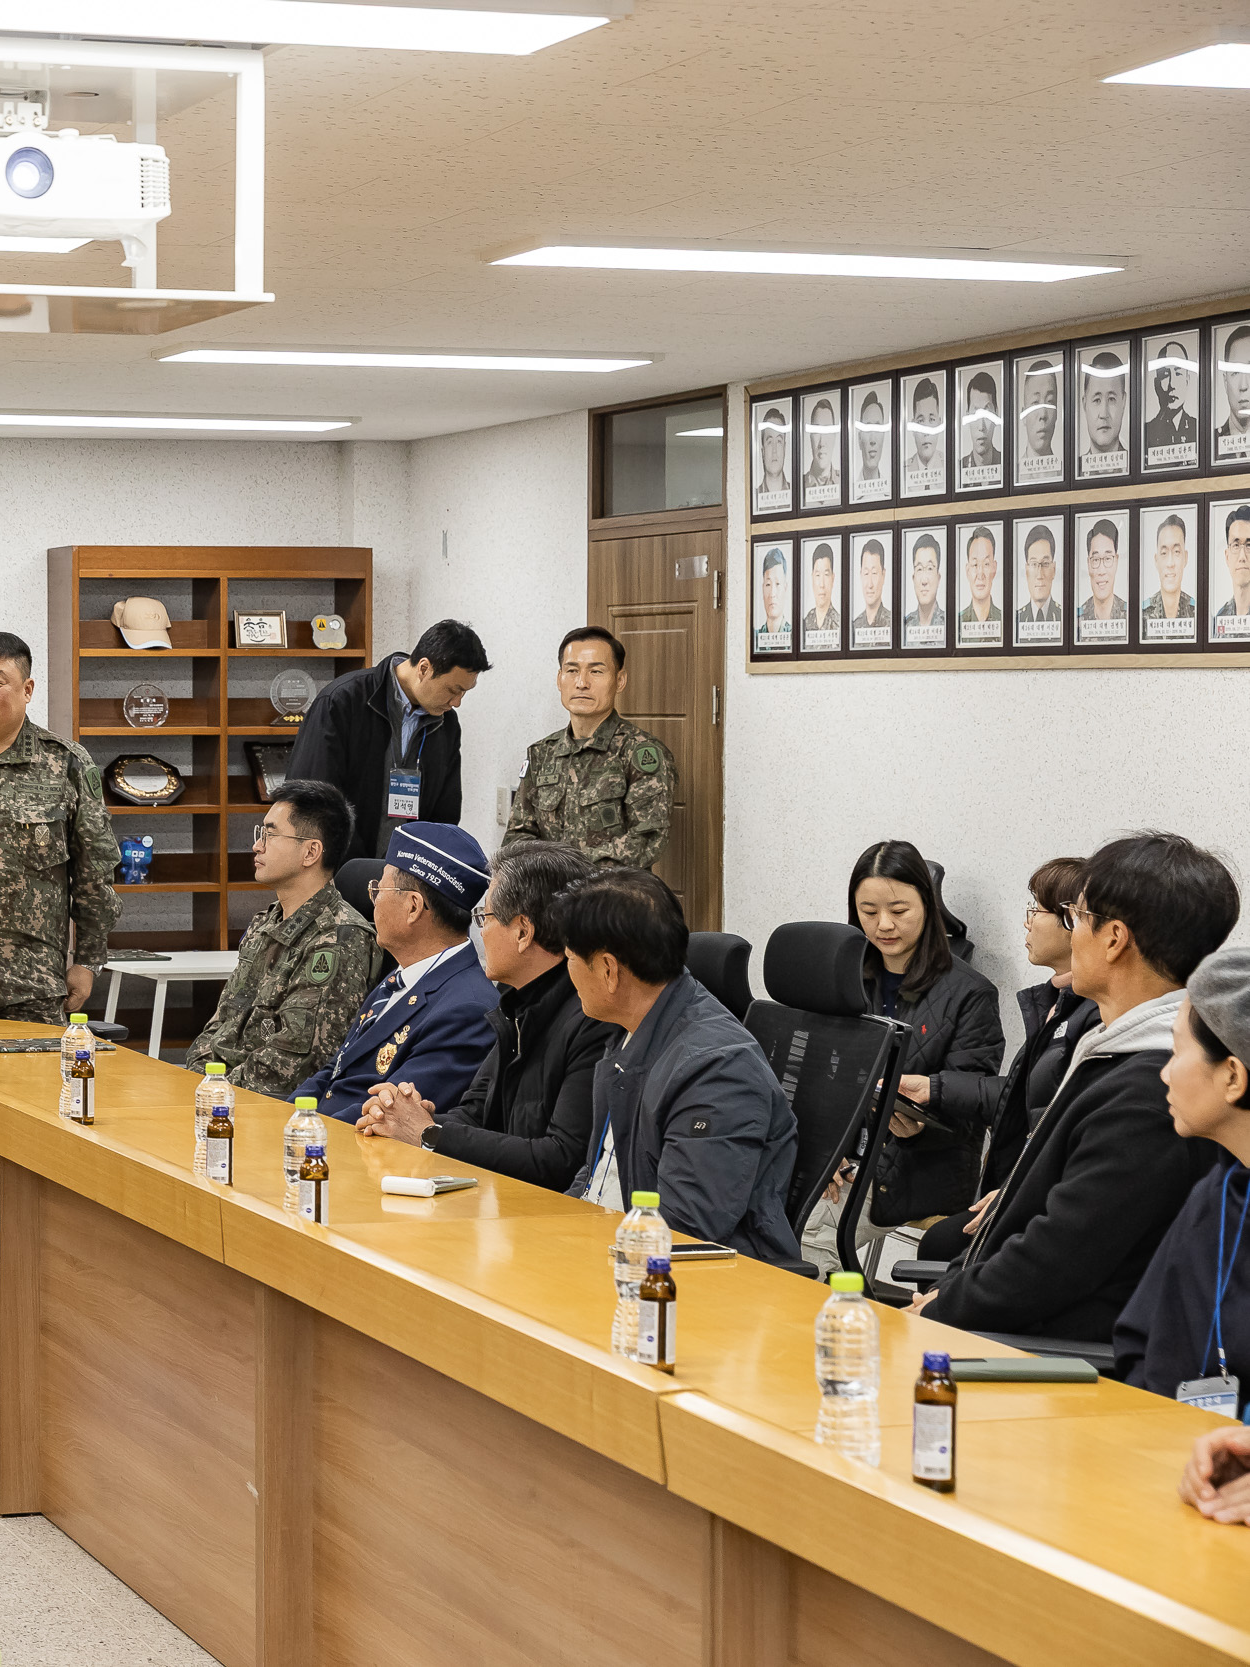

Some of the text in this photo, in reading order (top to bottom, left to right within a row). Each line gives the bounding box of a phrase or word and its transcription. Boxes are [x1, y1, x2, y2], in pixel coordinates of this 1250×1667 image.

[396, 850, 466, 894] Korean Veterans Association
[409, 863, 442, 886] Since 1952
